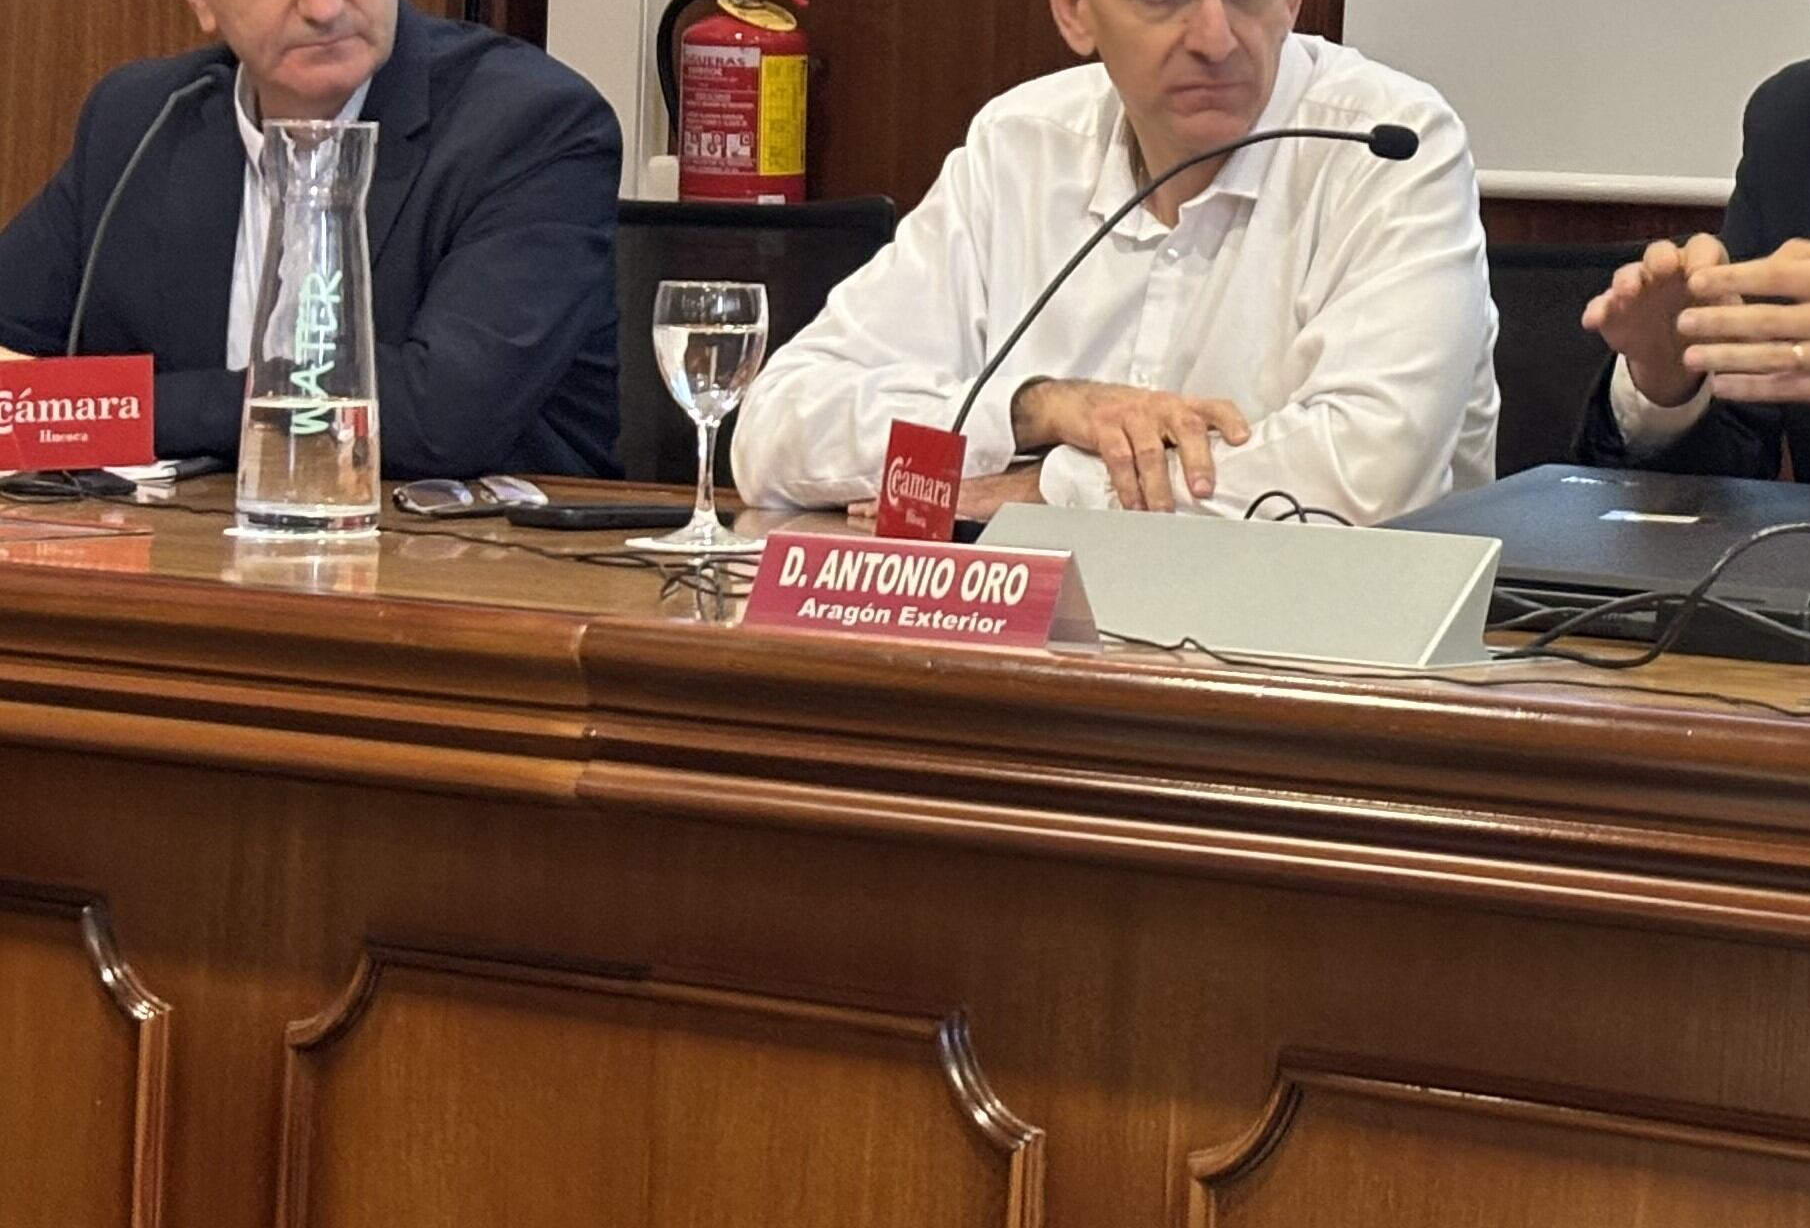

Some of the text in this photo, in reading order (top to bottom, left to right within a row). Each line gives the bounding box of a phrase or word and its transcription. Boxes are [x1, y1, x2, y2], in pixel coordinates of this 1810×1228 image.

[290, 270, 343, 436] WATER
[779, 546, 1029, 606] D. ANTONIO ORO
[798, 597, 1007, 635] Aragón Exterior
